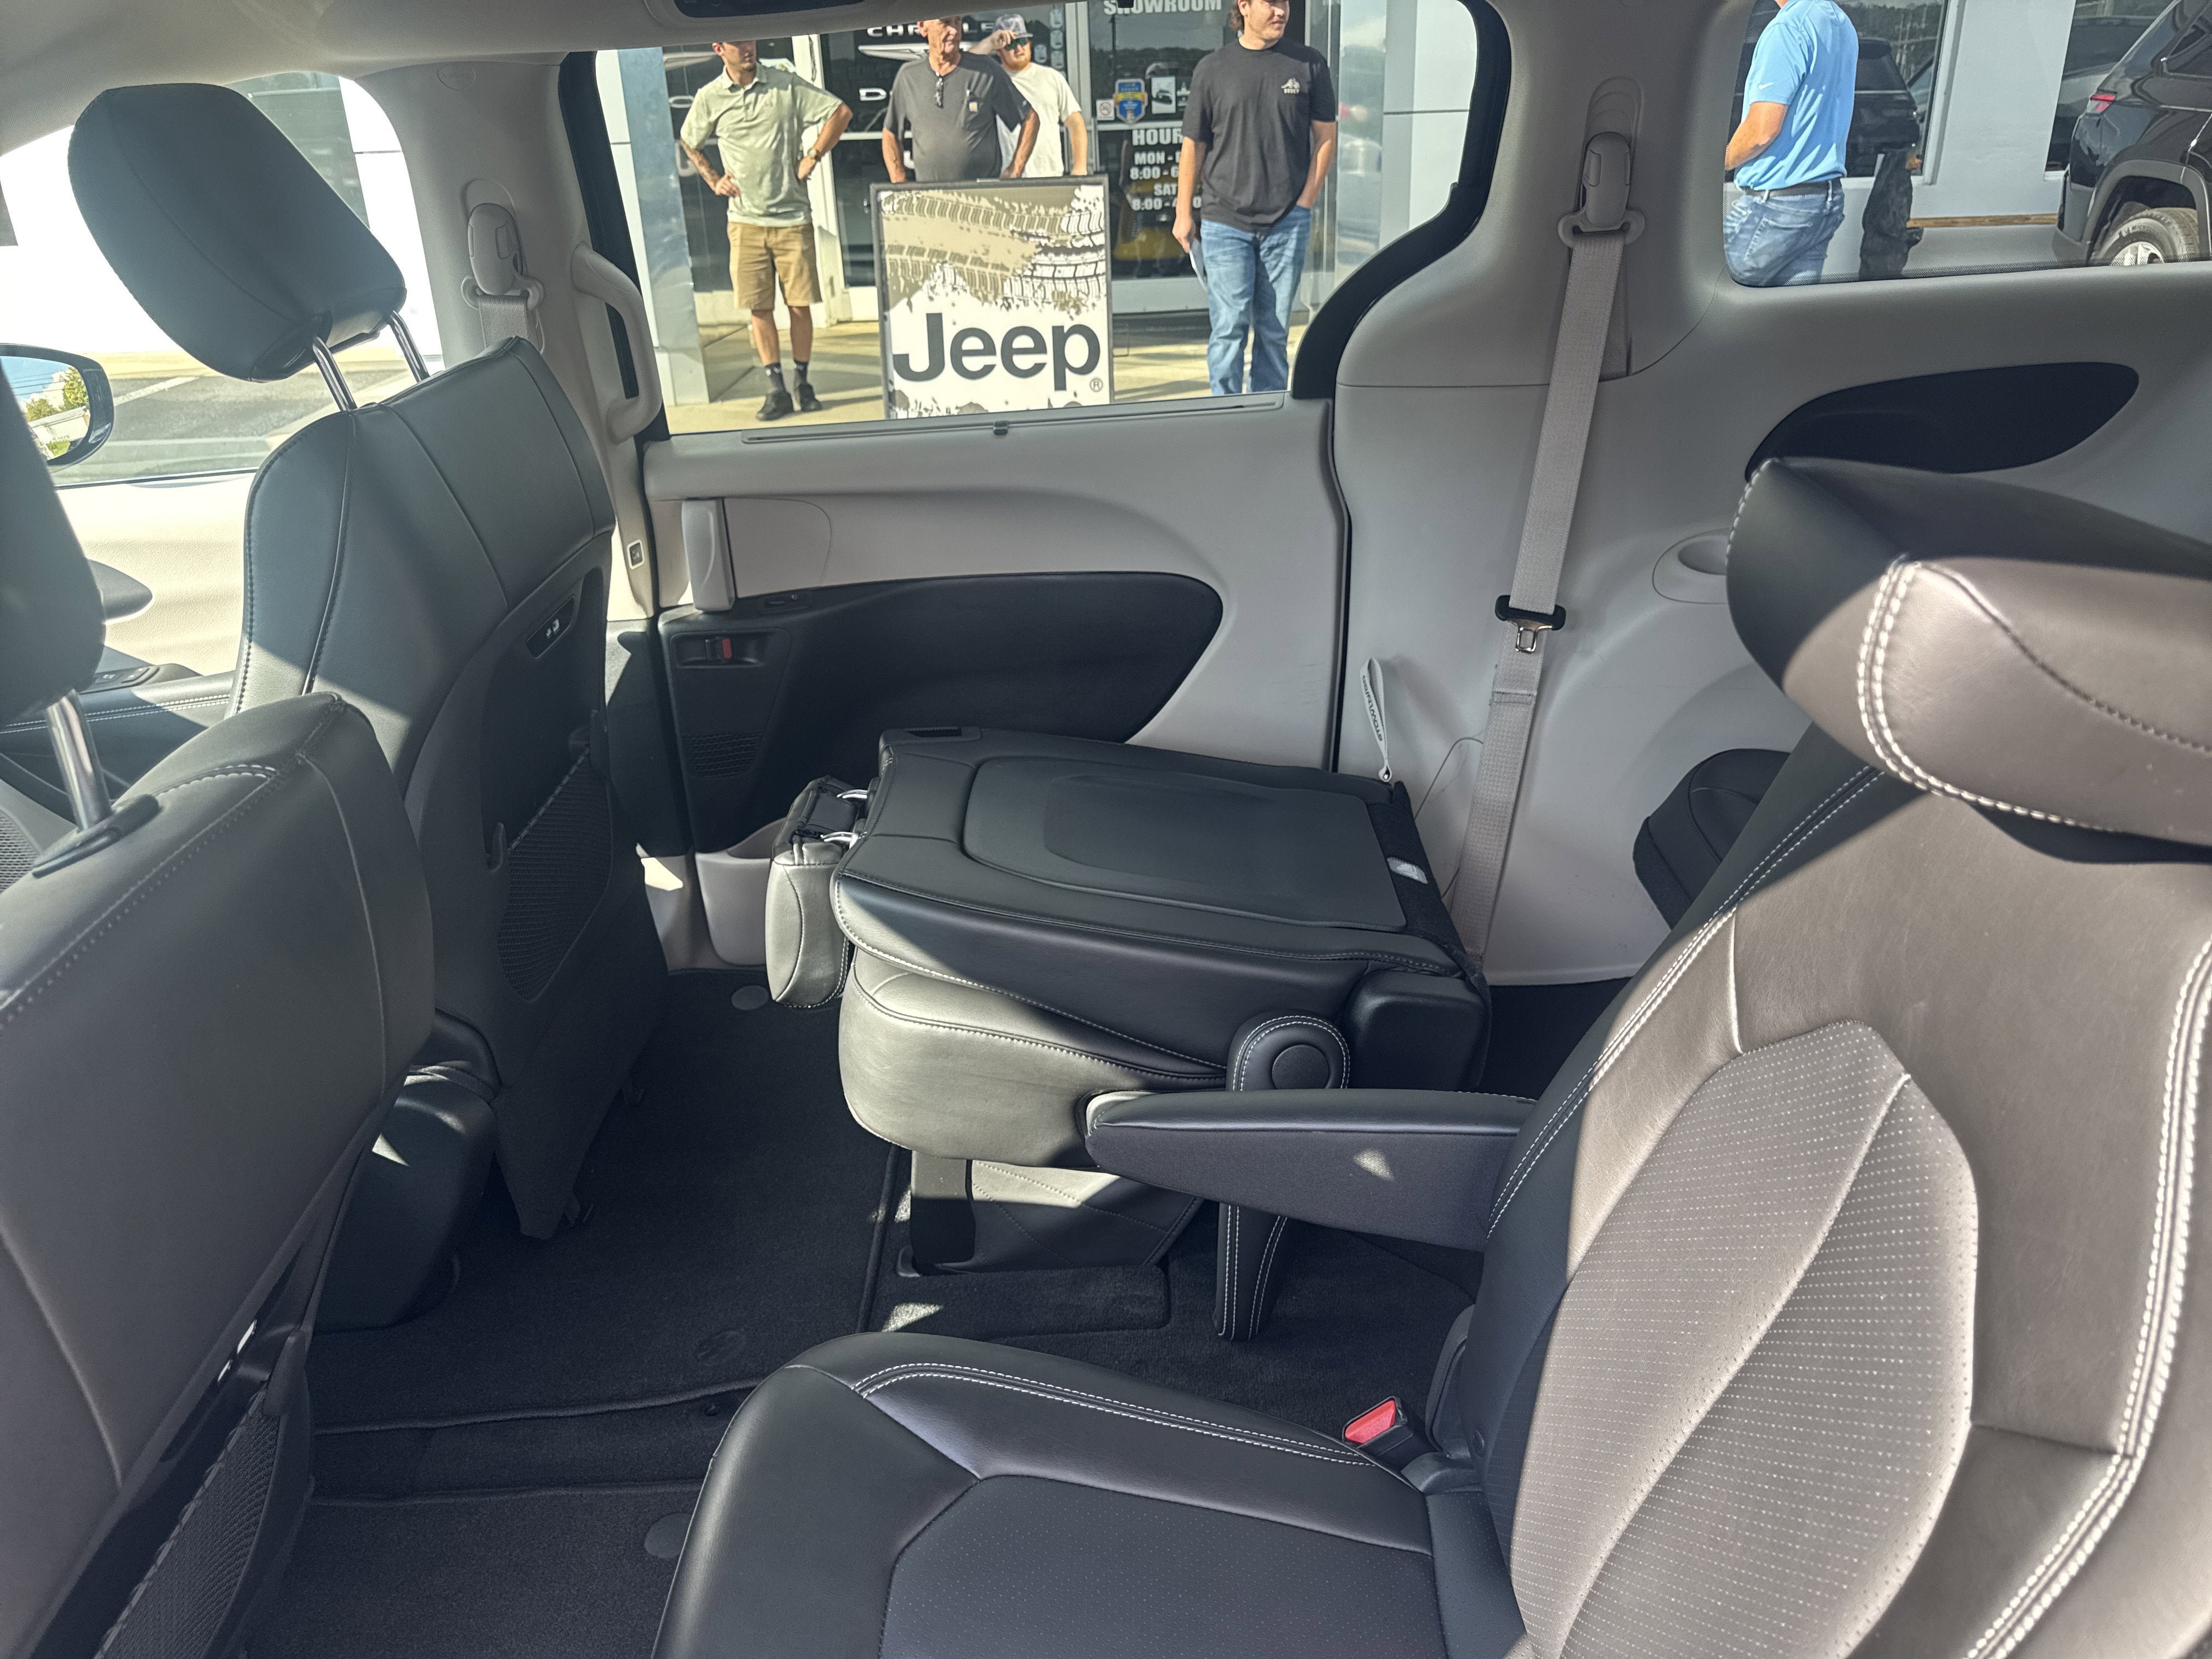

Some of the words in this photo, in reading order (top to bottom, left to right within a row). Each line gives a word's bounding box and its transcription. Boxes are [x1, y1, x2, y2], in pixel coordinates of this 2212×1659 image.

[867, 23, 994, 37] CHRLE
[1132, 128, 1183, 146] HOUR
[1134, 151, 1165, 165] MON
[1130, 166, 1161, 180] 8:00
[1131, 198, 1163, 211] 8:00
[893, 313, 1100, 391] Jeep
